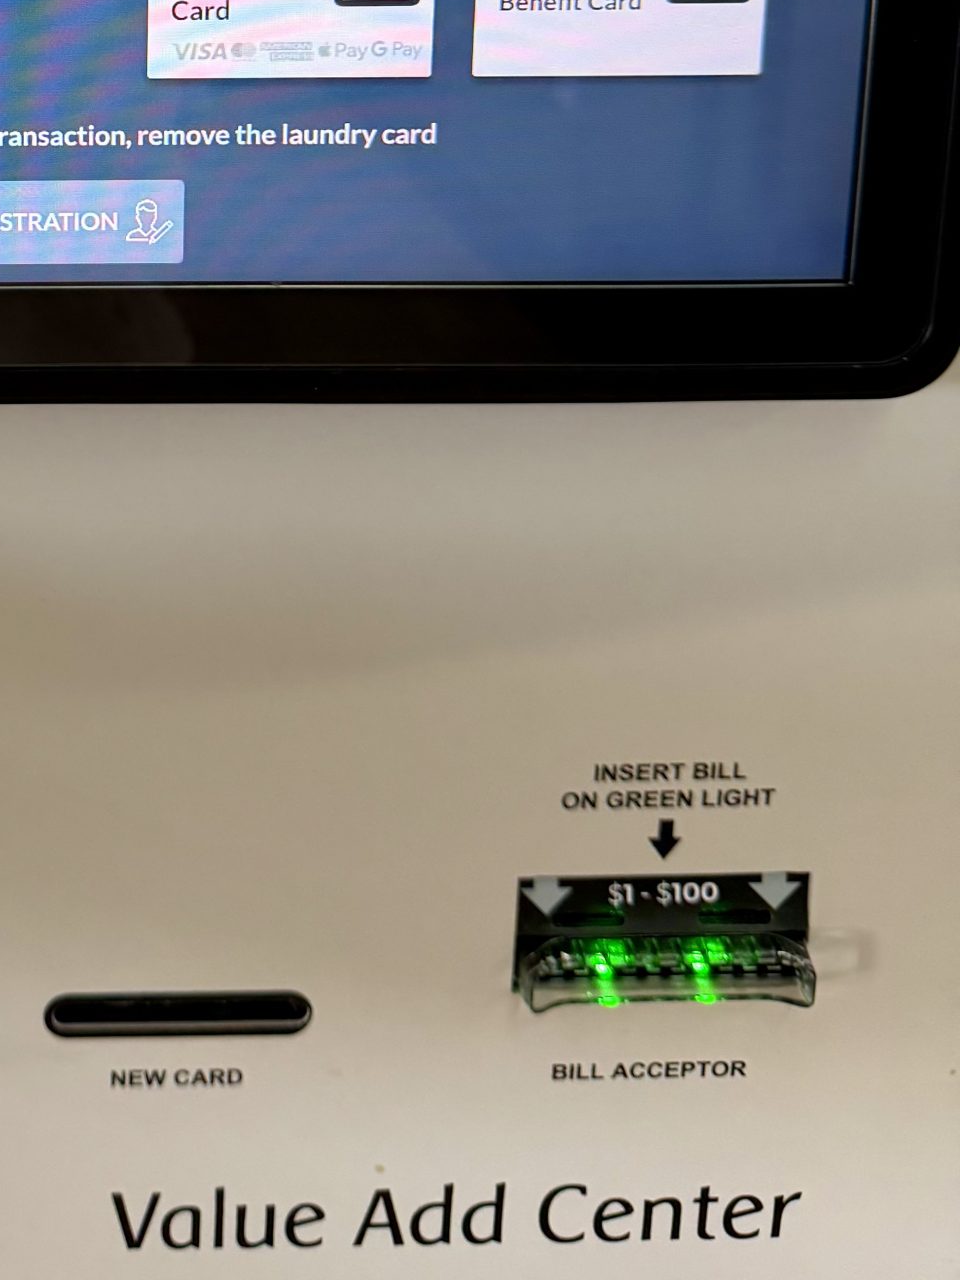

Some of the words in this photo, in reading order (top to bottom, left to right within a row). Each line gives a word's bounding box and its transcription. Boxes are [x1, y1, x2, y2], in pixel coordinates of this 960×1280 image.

[171, 0, 231, 22] Card
[173, 42, 228, 61] VISA
[334, 42, 368, 62] Pay
[392, 41, 423, 61] Pay
[138, 130, 230, 147] remove
[235, 123, 276, 146] the
[281, 123, 376, 151] laundry
[381, 122, 437, 146] card
[593, 763, 685, 781] INSERT
[692, 762, 746, 780] BILL
[561, 792, 597, 810] ON
[606, 790, 693, 809] GREEN
[701, 788, 776, 807] LIGHT
[608, 881, 635, 907] $1
[656, 880, 720, 907] $100
[110, 1068, 167, 1087] NEW
[173, 1068, 244, 1087] CARD
[551, 1062, 605, 1081] BILL
[611, 1060, 747, 1080] ACCEPTOR
[111, 1186, 326, 1251] Value
[352, 1182, 508, 1247] Add
[538, 1183, 803, 1244] Center
